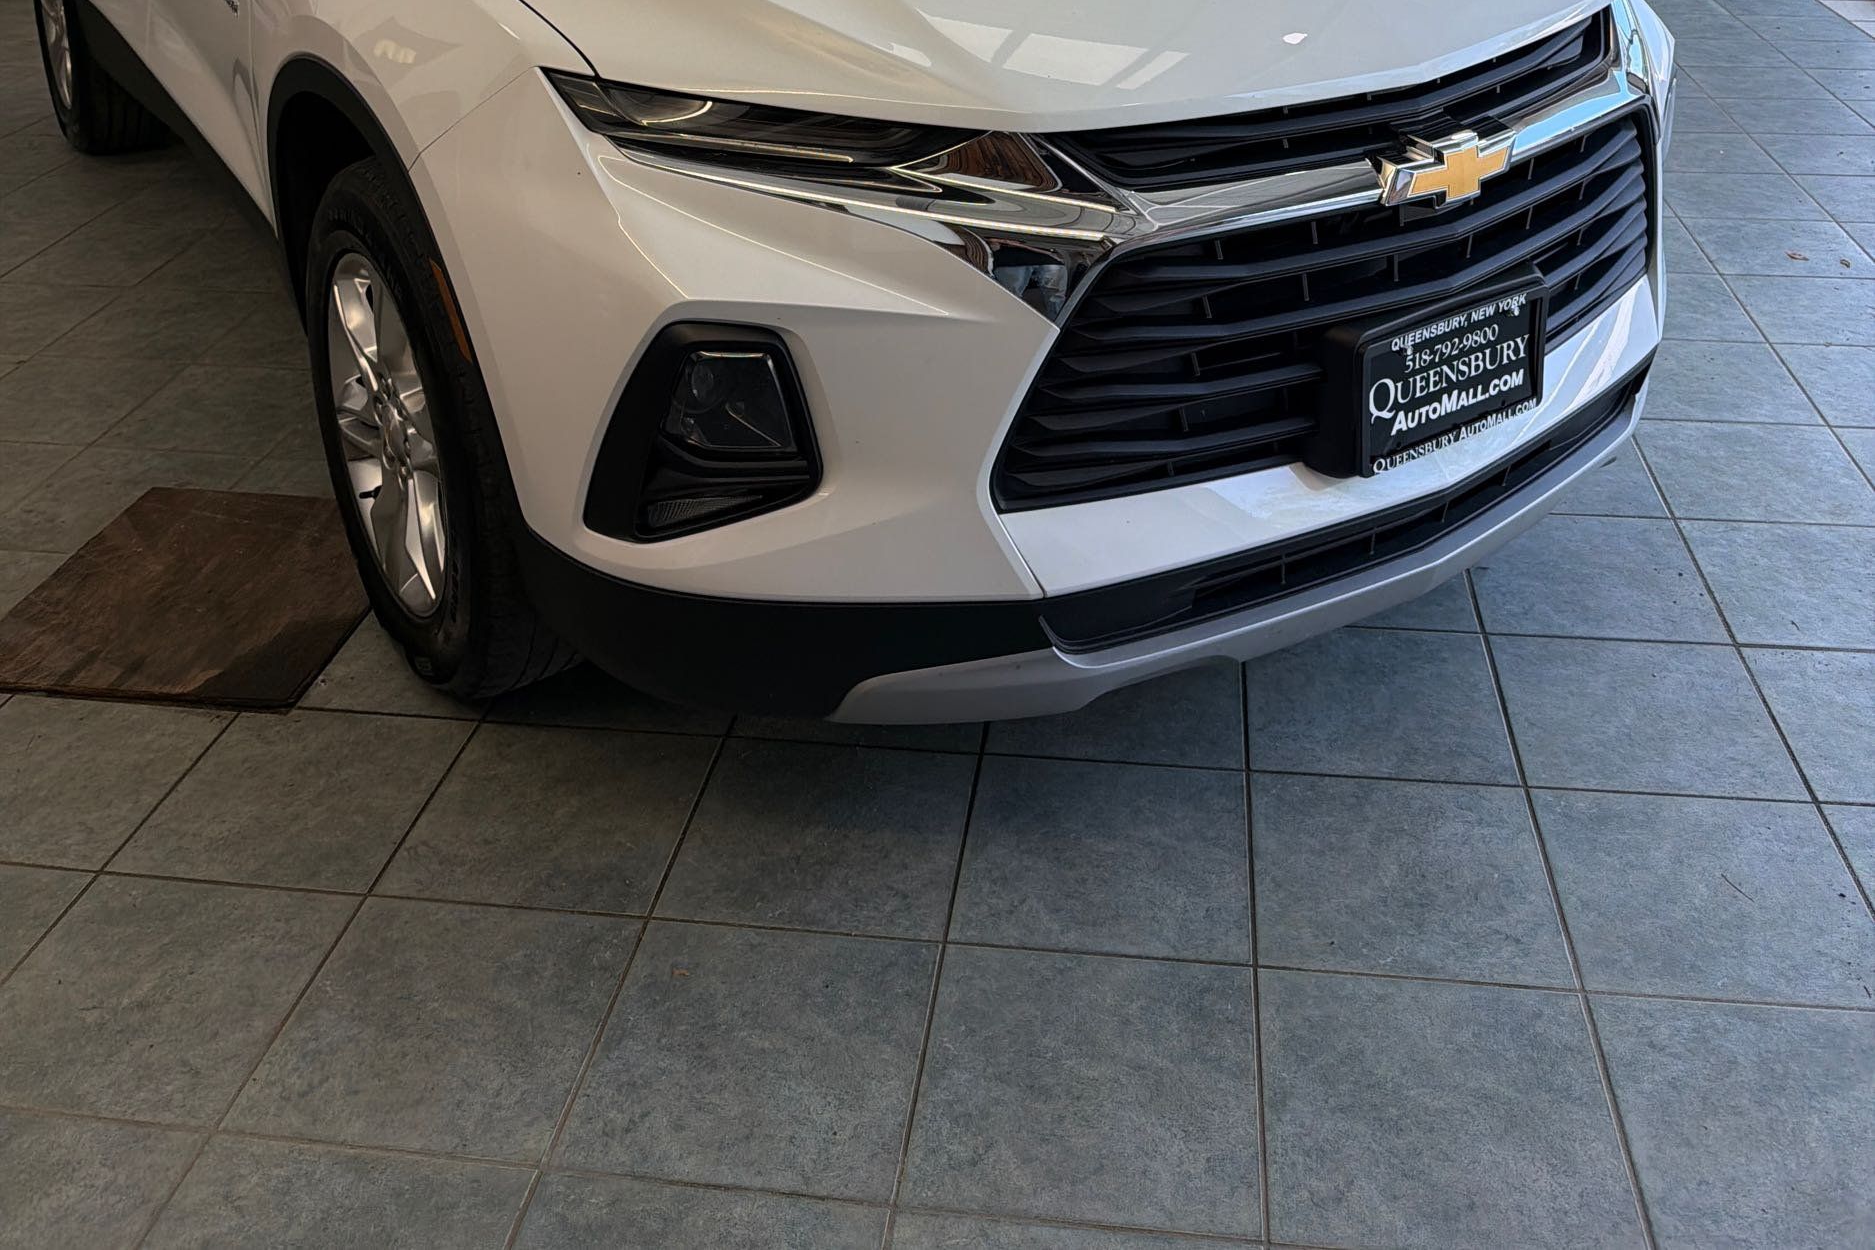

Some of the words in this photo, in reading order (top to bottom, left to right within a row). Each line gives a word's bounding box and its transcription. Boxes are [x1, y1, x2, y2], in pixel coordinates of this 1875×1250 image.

[1391, 313, 1468, 352] QUEENSBURY,
[1470, 305, 1496, 324] NEW
[1498, 293, 1528, 314] YORK
[1404, 323, 1499, 374] 518-792-9800
[1368, 334, 1531, 425] QUEENSBURY
[1372, 432, 1456, 475] QUEENSBURY
